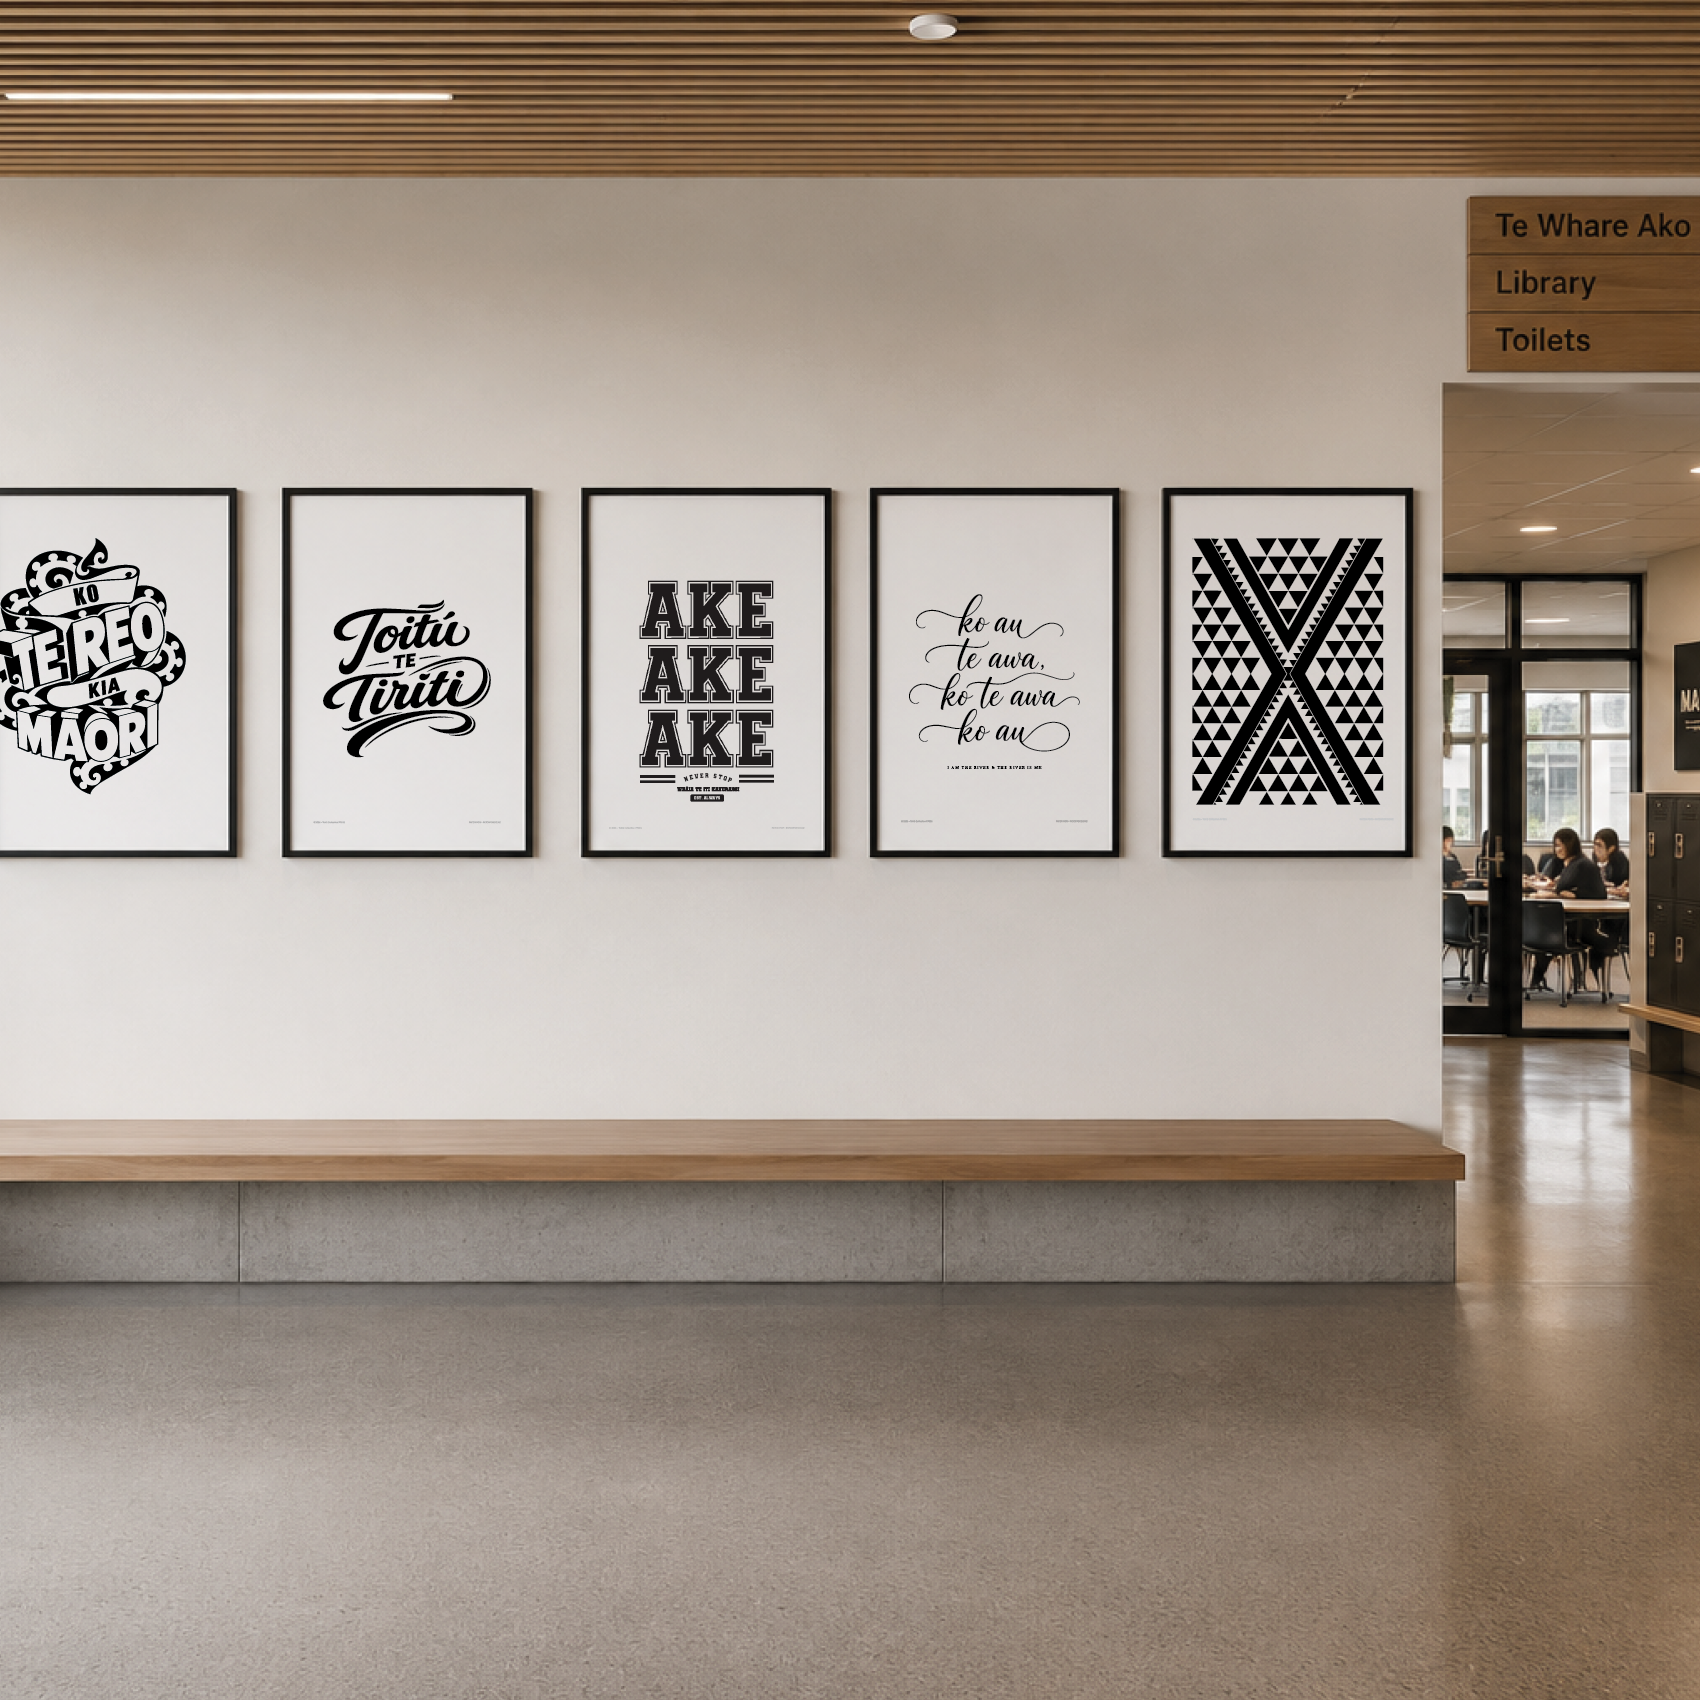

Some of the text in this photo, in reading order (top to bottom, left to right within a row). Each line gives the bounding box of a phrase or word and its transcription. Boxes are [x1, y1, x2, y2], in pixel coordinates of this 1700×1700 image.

[1495, 212, 1691, 238] Te Whare Ako
[1496, 269, 1596, 301] Library
[1495, 327, 1591, 352] Toilets
[73, 584, 99, 606] KO
[639, 580, 774, 640] AKE
[994, 617, 1064, 638] au
[5, 602, 165, 691] TE REO
[392, 653, 417, 669] TE
[925, 638, 1045, 671] te awa,
[88, 677, 121, 699] KIA
[639, 644, 774, 704] AKE
[909, 673, 973, 710] ko
[1010, 690, 1080, 707] awa
[1681, 688, 1700, 712] NA
[17, 703, 158, 762] MĀORI
[639, 709, 774, 768] AKE
[995, 721, 1070, 752] au
[683, 772, 733, 783] NEVER STOP
